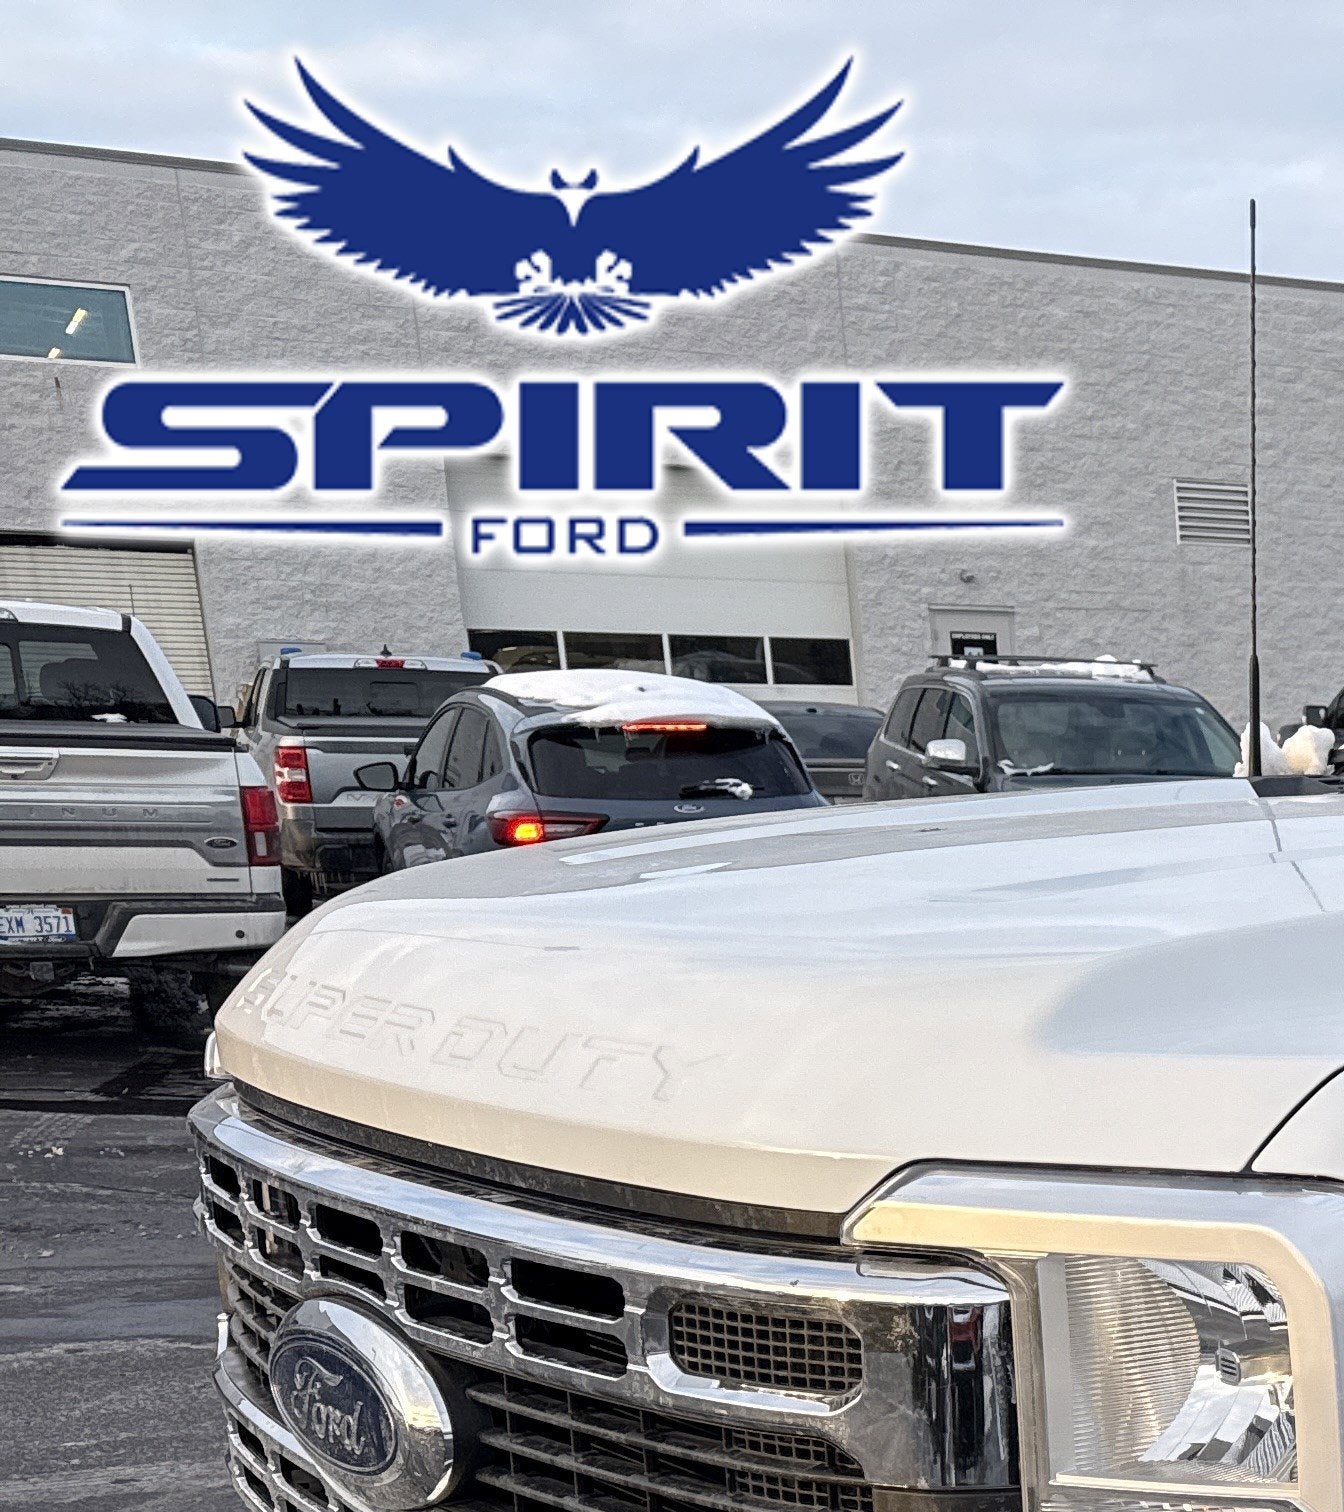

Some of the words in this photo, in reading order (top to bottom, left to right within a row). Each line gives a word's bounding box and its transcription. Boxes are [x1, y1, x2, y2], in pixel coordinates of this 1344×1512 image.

[34, 915, 72, 933] 3571
[431, 1014, 723, 1101] DUTY
[288, 1354, 368, 1458] Ford
